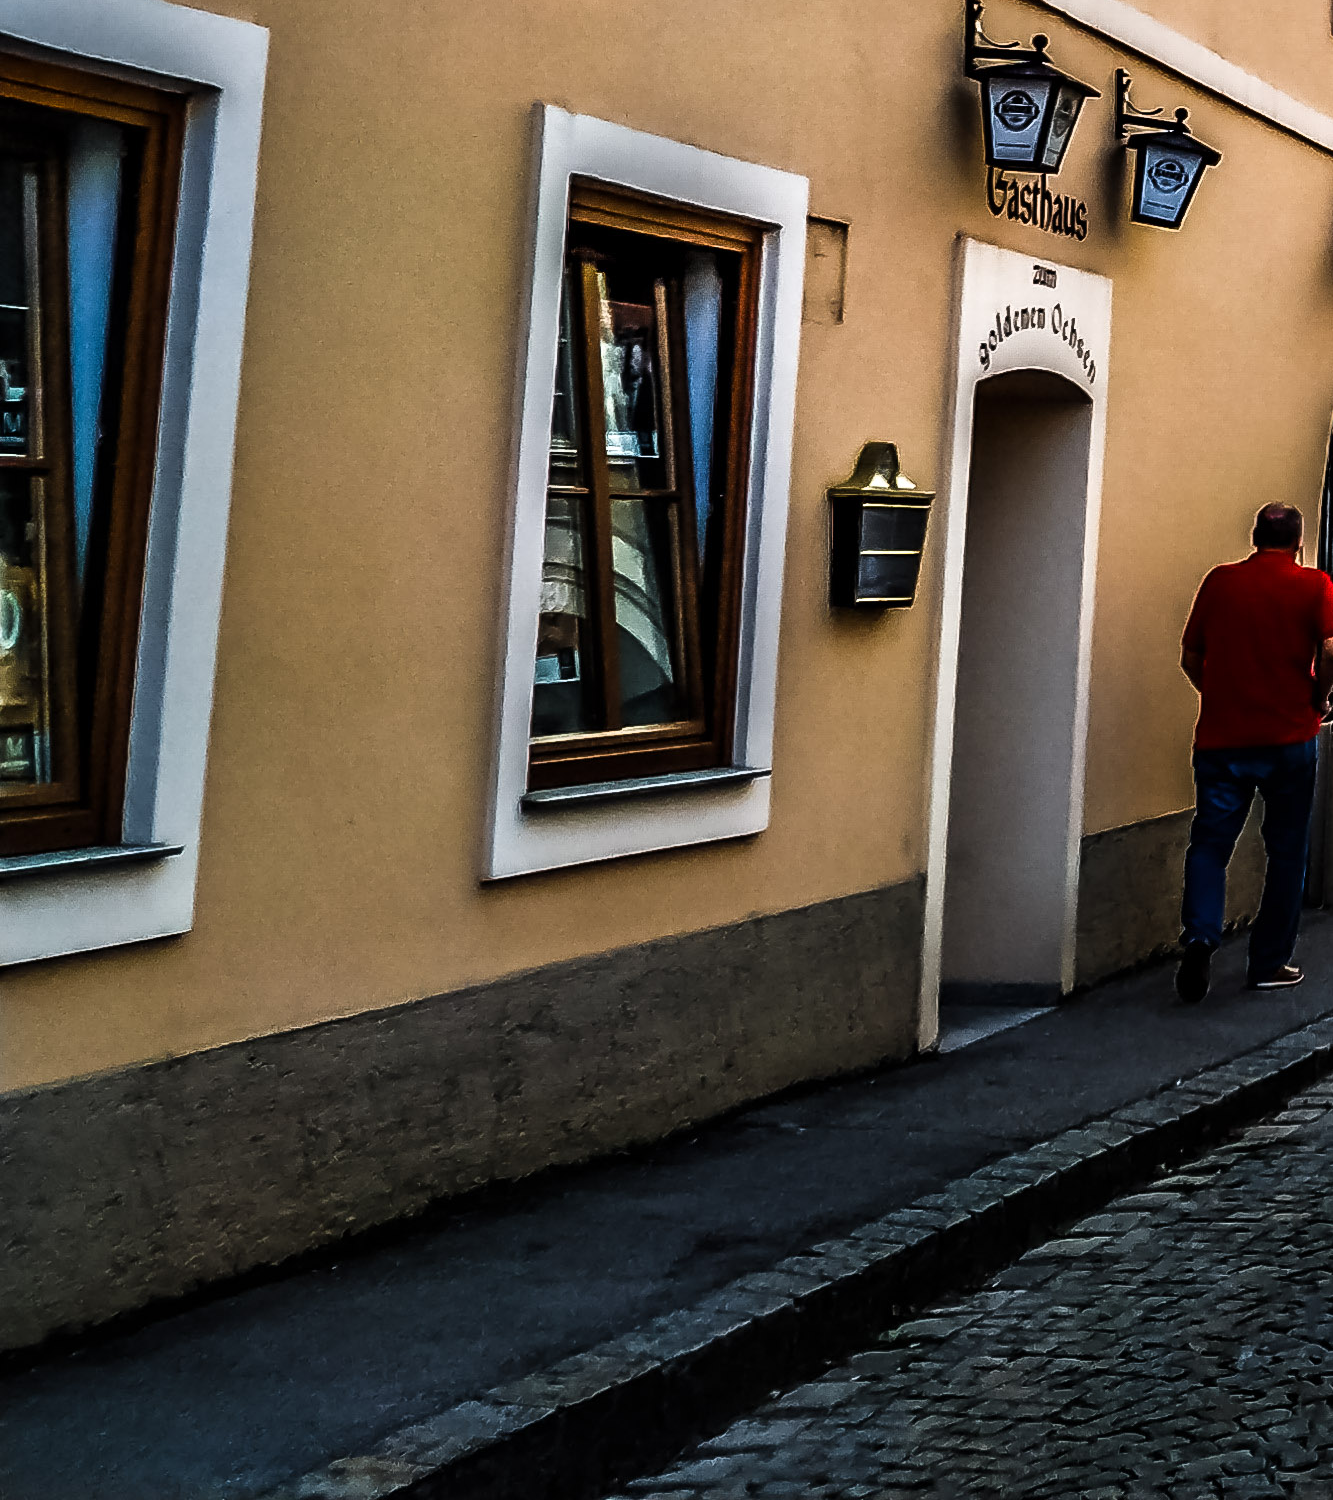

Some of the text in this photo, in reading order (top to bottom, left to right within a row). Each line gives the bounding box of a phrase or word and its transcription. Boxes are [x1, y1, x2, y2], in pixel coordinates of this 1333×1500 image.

[986, 166, 1089, 241] Gasthaus
[1032, 264, 1057, 289] zum
[979, 303, 1096, 385] goldenen Ochsen
